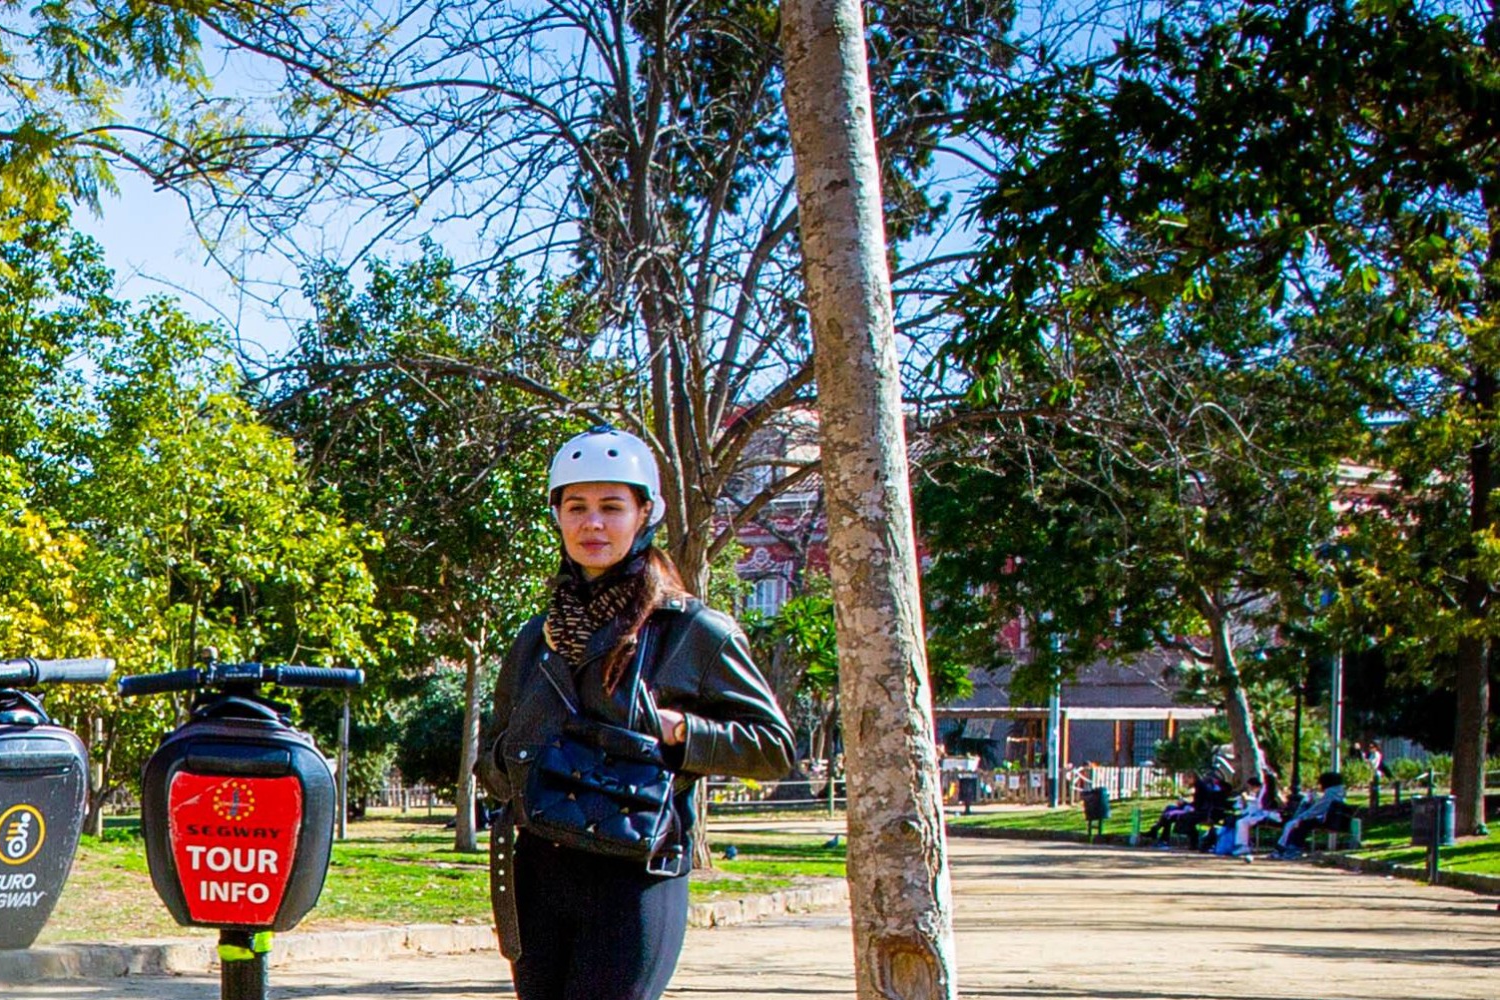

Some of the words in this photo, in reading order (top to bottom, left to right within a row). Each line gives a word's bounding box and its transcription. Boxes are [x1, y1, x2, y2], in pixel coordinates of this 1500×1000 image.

[187, 824, 280, 838] SEGWAY
[185, 845, 278, 874] TOUR
[200, 880, 270, 904] INFO
